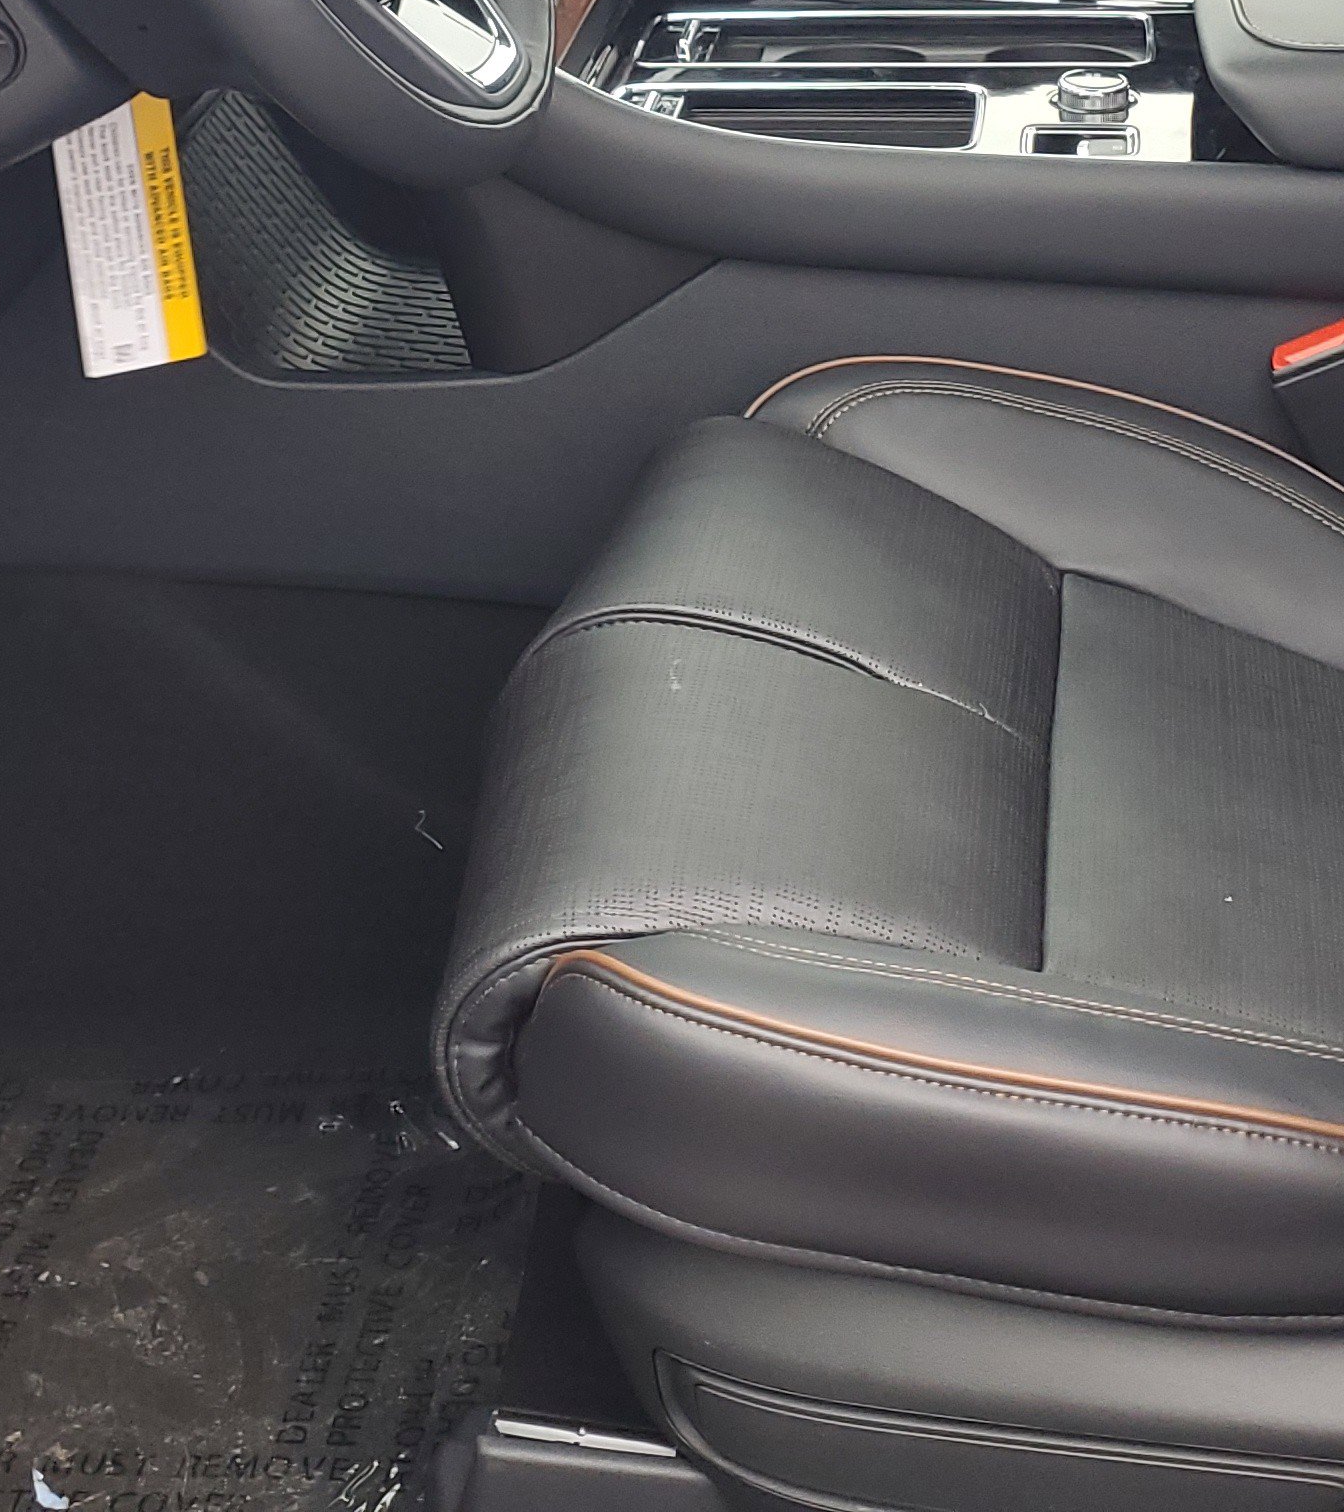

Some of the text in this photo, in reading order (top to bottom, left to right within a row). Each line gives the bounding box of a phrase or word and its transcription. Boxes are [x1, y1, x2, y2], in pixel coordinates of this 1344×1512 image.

[142, 151, 158, 181] WITH
[158, 147, 173, 173] THIS
[147, 184, 168, 244] ADVANCED
[163, 177, 181, 222] VEHICLE
[43, 1102, 194, 1126] REMOVE
[326, 1285, 406, 1448] PROTECTIVE
[275, 1340, 337, 1445] DEALER
[174, 1453, 354, 1482] REMOVE
